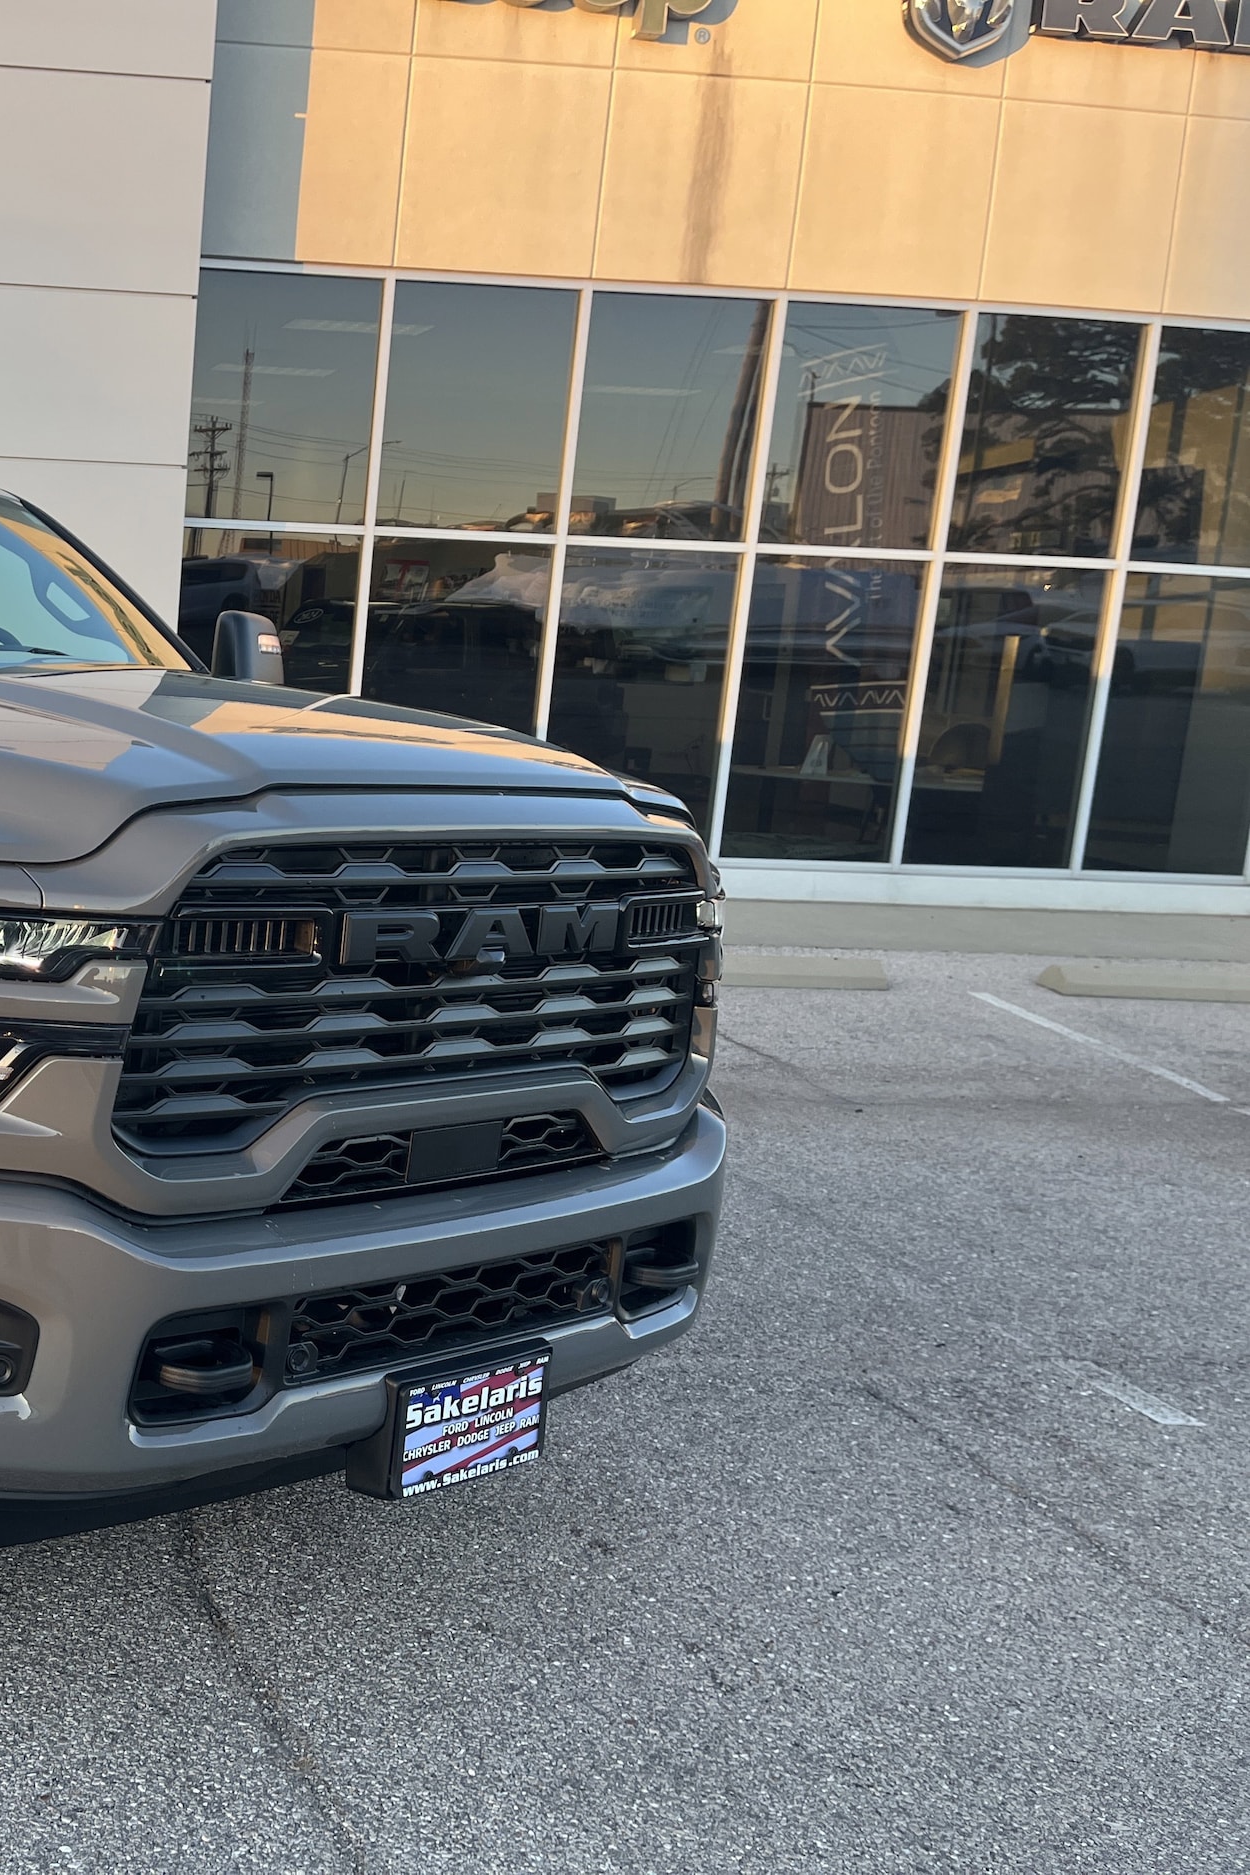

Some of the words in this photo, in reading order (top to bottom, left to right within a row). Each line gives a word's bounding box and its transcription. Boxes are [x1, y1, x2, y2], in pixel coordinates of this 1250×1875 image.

[1032, 0, 1250, 48] RA
[340, 902, 620, 966] RAM
[409, 1387, 426, 1396] FORD
[431, 1380, 457, 1390] LINCOLN
[463, 1372, 490, 1384] CHRYSLER
[495, 1366, 514, 1376] DODGE
[518, 1360, 531, 1369] JEEP
[536, 1356, 549, 1365] RAM
[406, 1375, 542, 1429] Sakelaris
[442, 1420, 468, 1436] FORD
[474, 1407, 514, 1427] LINCOLN
[403, 1439, 451, 1462] CHRYSLER
[457, 1429, 489, 1447] DODGE
[495, 1421, 516, 1437] JEEP
[520, 1414, 540, 1429] RAM
